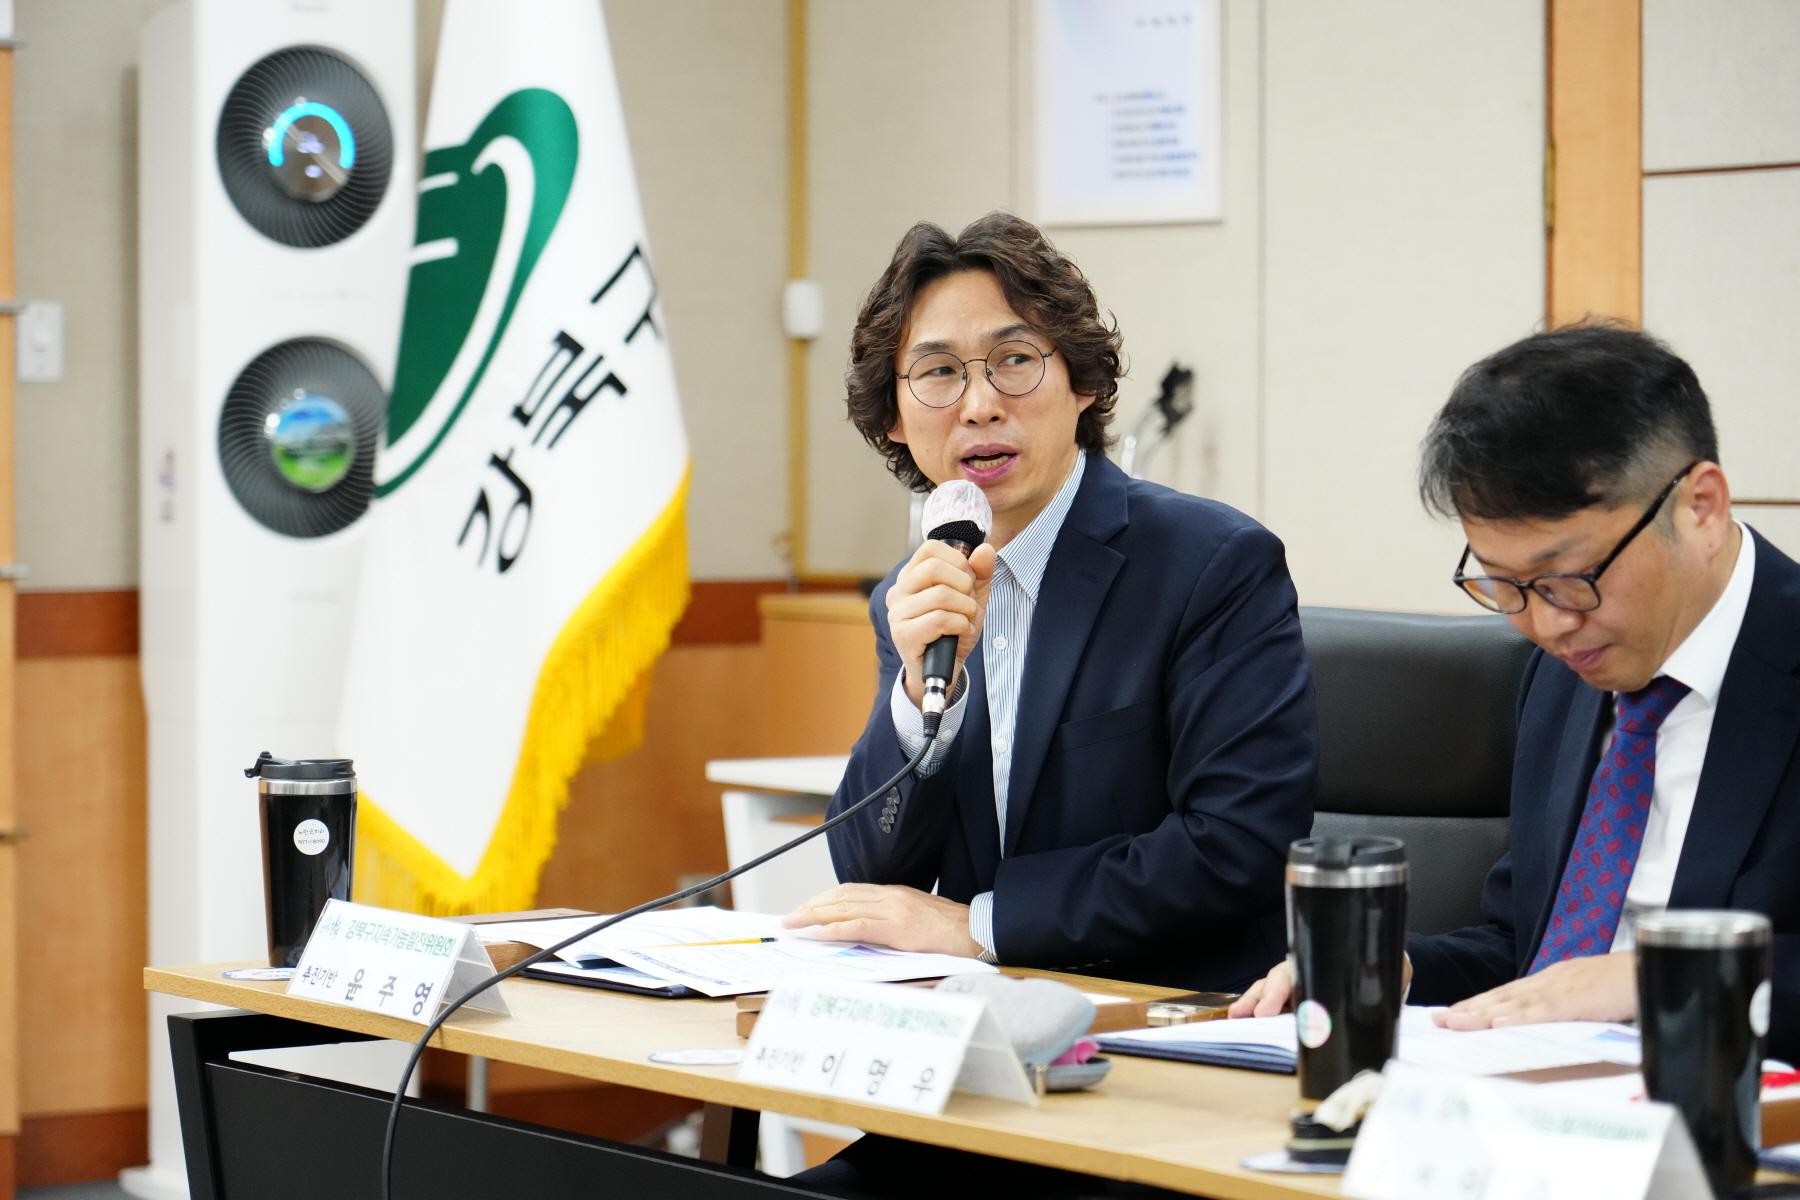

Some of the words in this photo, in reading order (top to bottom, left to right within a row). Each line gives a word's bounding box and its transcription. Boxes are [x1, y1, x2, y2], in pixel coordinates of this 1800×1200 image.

[457, 243, 662, 574] 강북구
[345, 919, 457, 958] 강북구지속가능발전위원회
[303, 965, 338, 989] 추진기반
